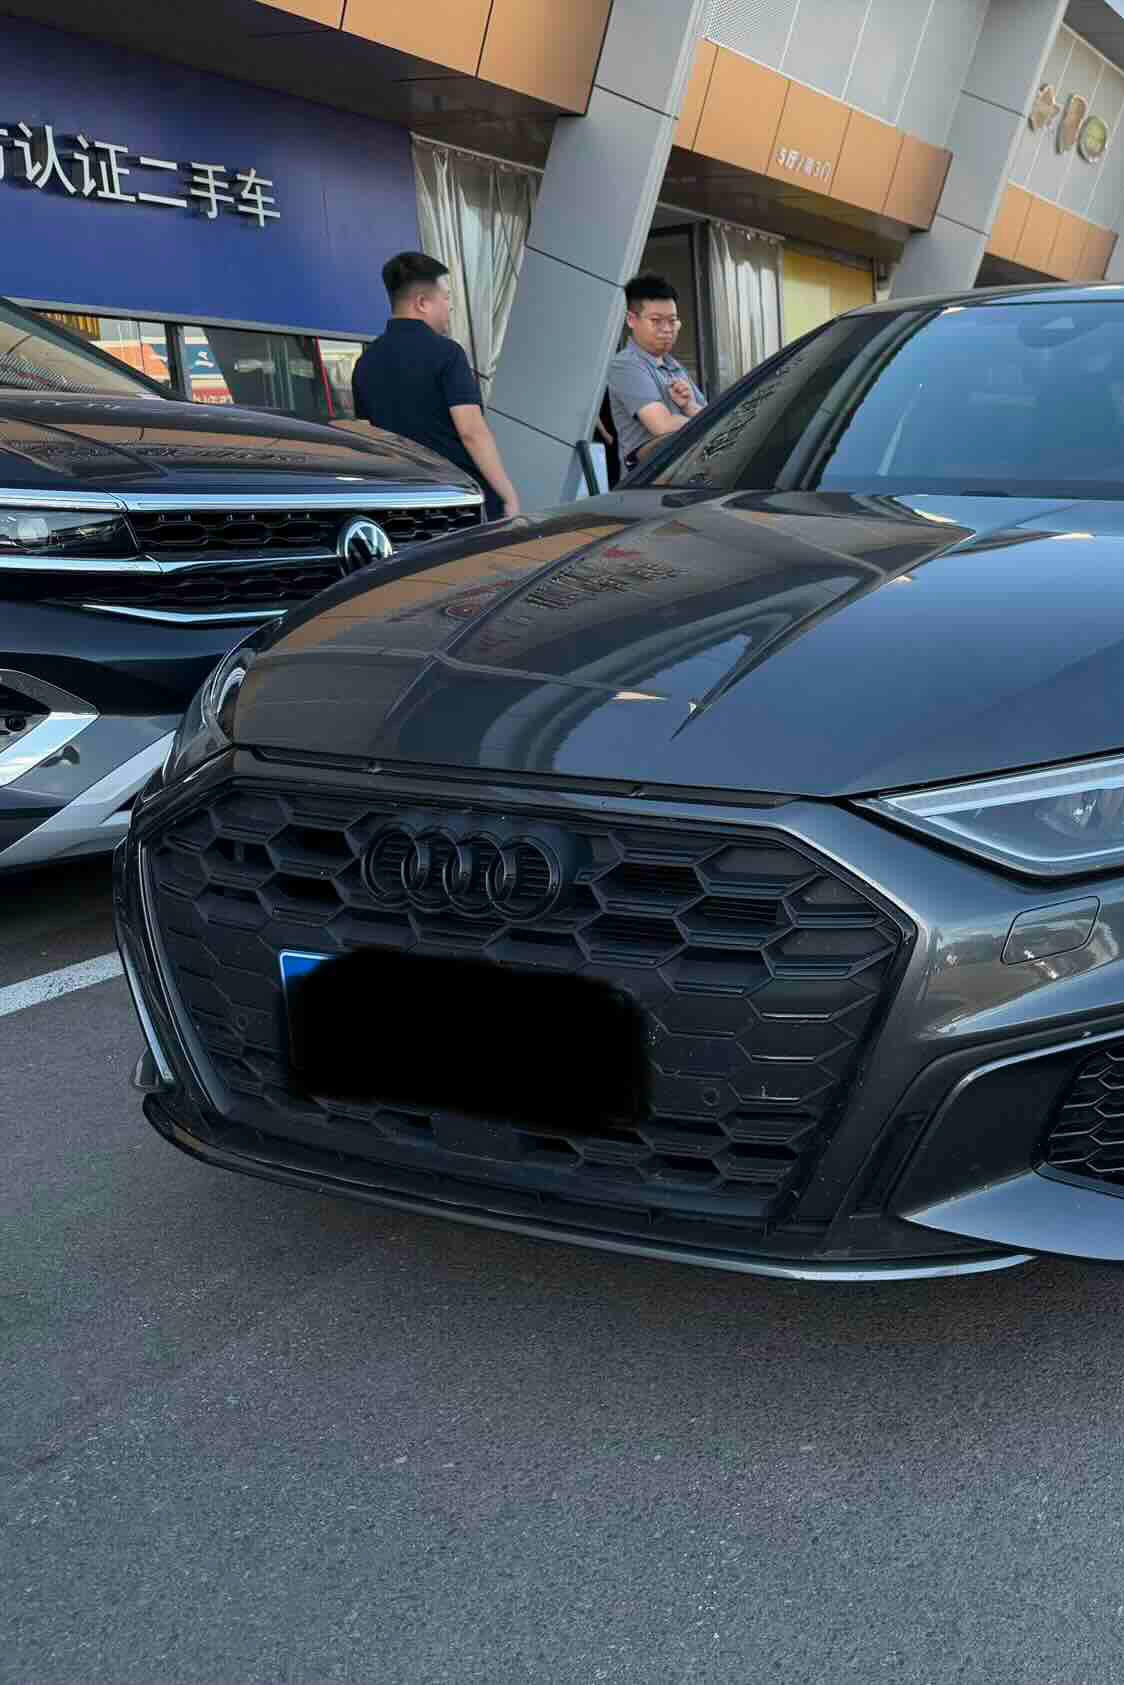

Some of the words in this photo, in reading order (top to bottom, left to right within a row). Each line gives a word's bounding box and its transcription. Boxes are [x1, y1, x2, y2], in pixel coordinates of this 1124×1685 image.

[0, 121, 281, 227] 认证二手车
